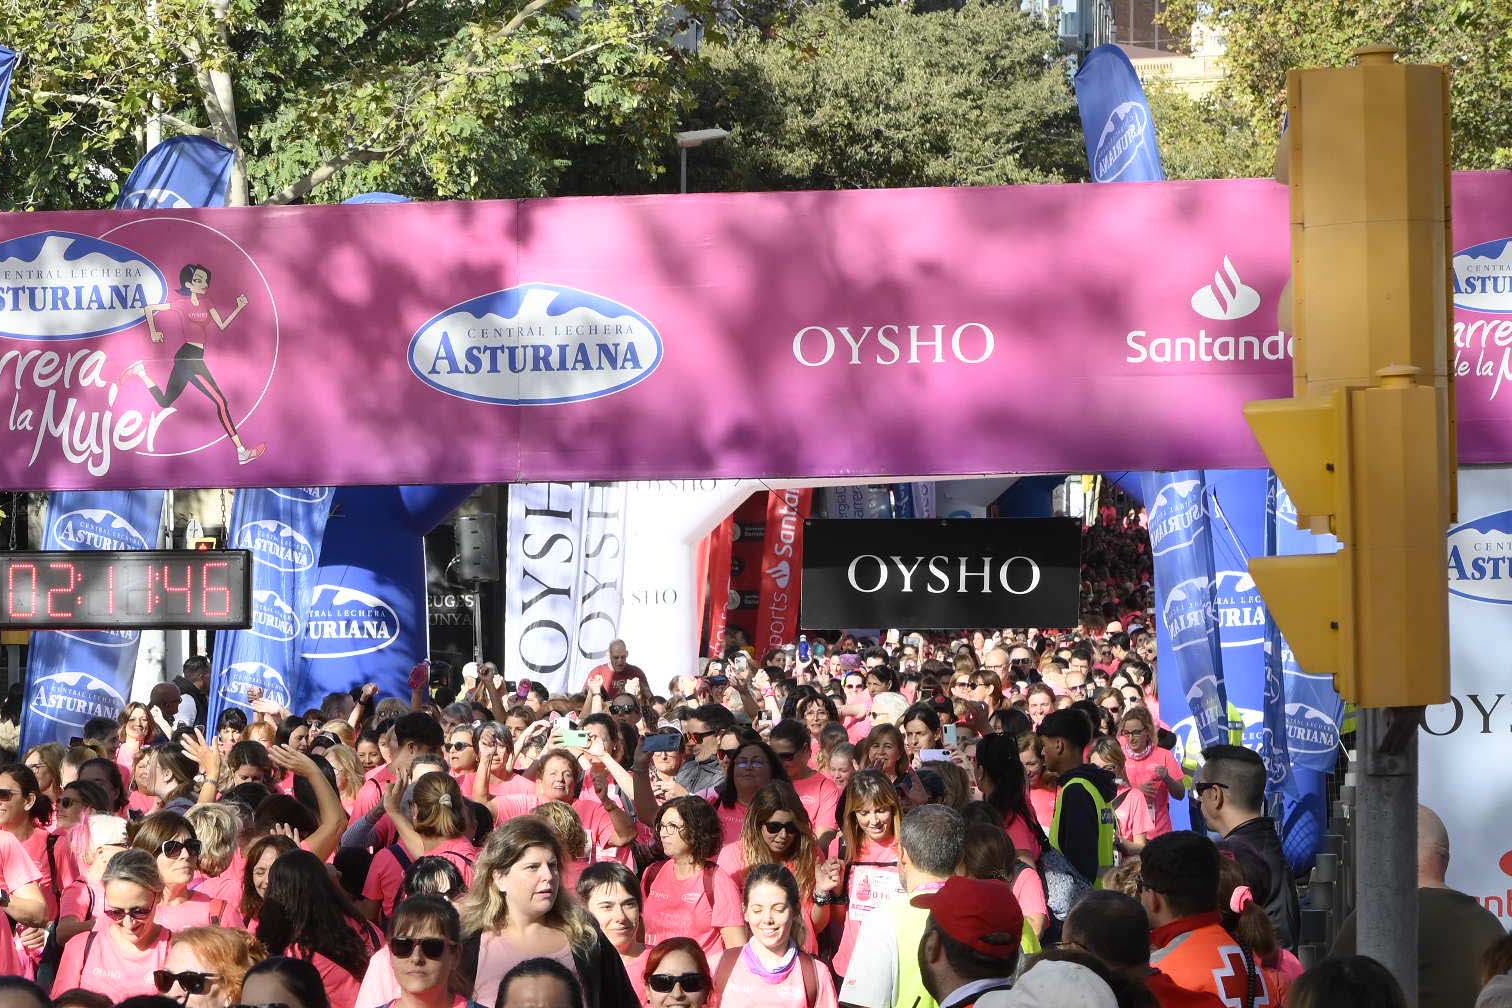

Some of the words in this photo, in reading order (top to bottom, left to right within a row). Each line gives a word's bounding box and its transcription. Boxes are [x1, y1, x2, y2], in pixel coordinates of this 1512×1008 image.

[70, 266, 143, 279] LECHERA
[467, 325, 543, 339] CENTRAL
[553, 323, 634, 337] LECHERA
[793, 323, 995, 367] OYSHO
[429, 331, 643, 376] ASTURIANA
[10, 396, 33, 432] la
[28, 381, 177, 477] Mujer
[775, 488, 799, 557] Santa
[519, 483, 573, 673] OYSH
[578, 482, 620, 660] OYSH
[847, 555, 1041, 595] OYSHO
[32, 685, 120, 721] ASTURIANA
